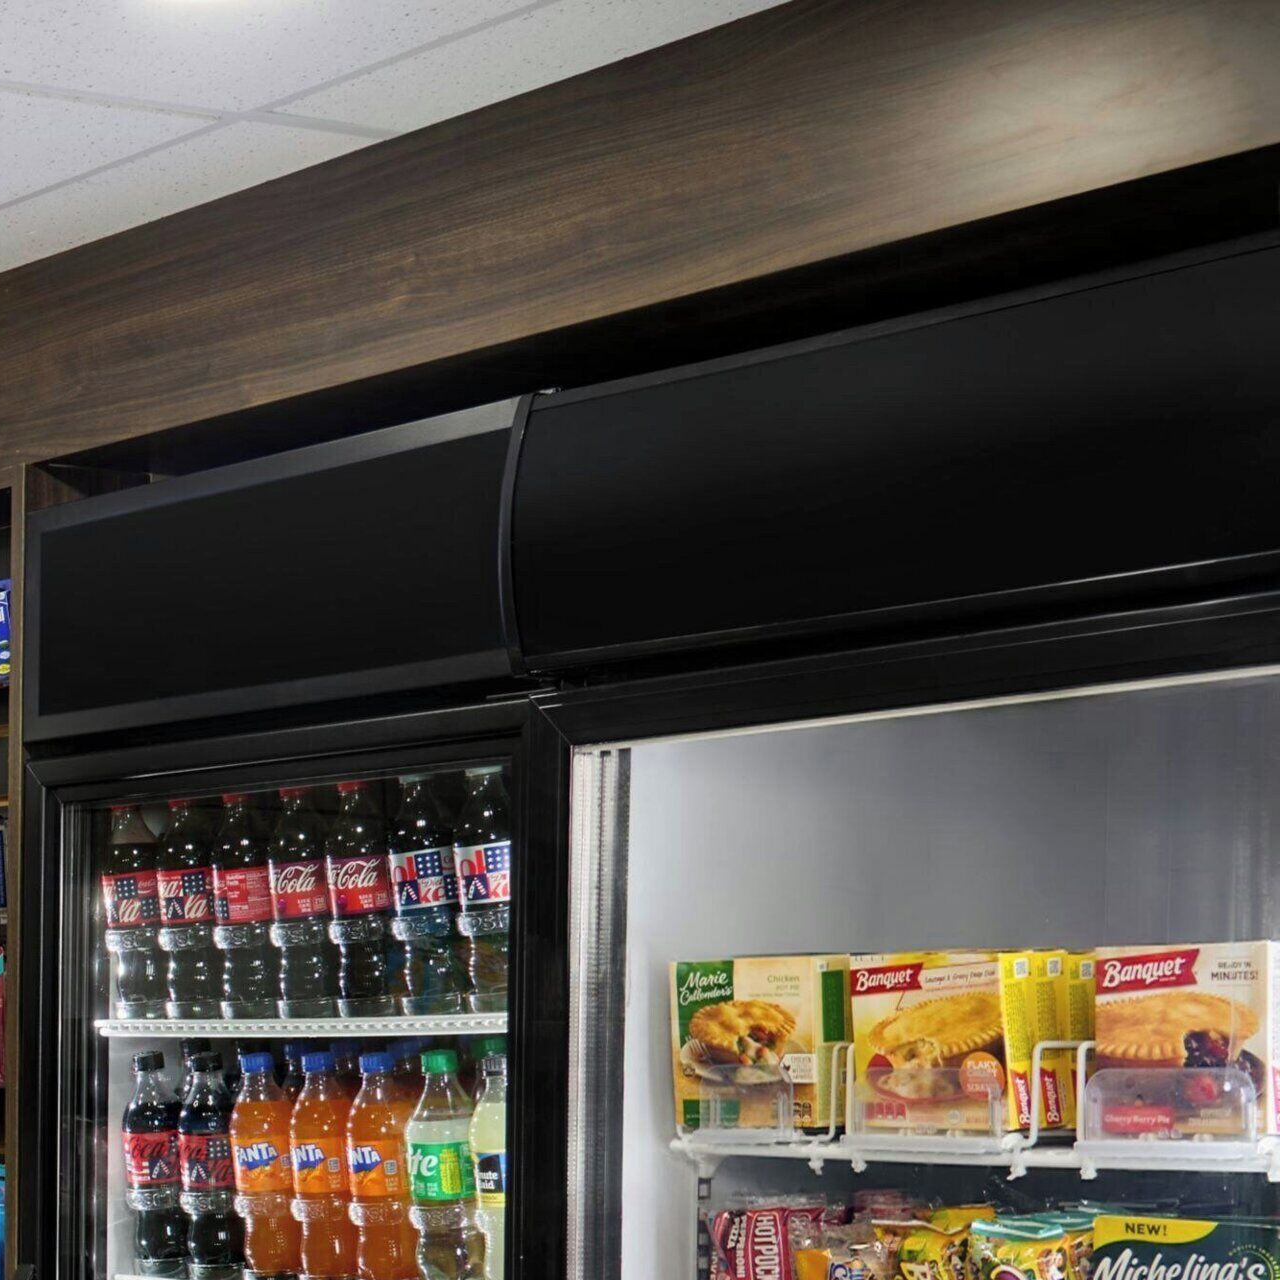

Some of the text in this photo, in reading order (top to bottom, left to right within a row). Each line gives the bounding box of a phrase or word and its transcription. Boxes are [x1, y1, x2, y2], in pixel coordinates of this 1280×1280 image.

[681, 969, 729, 993] Marie
[855, 968, 914, 992] Banquet
[1102, 955, 1185, 989] Banquet
[679, 985, 734, 1006] Callender's
[967, 1060, 999, 1072] FLAKY
[1043, 1073, 1060, 1123] Banquet
[1124, 1222, 1169, 1236] NEW!
